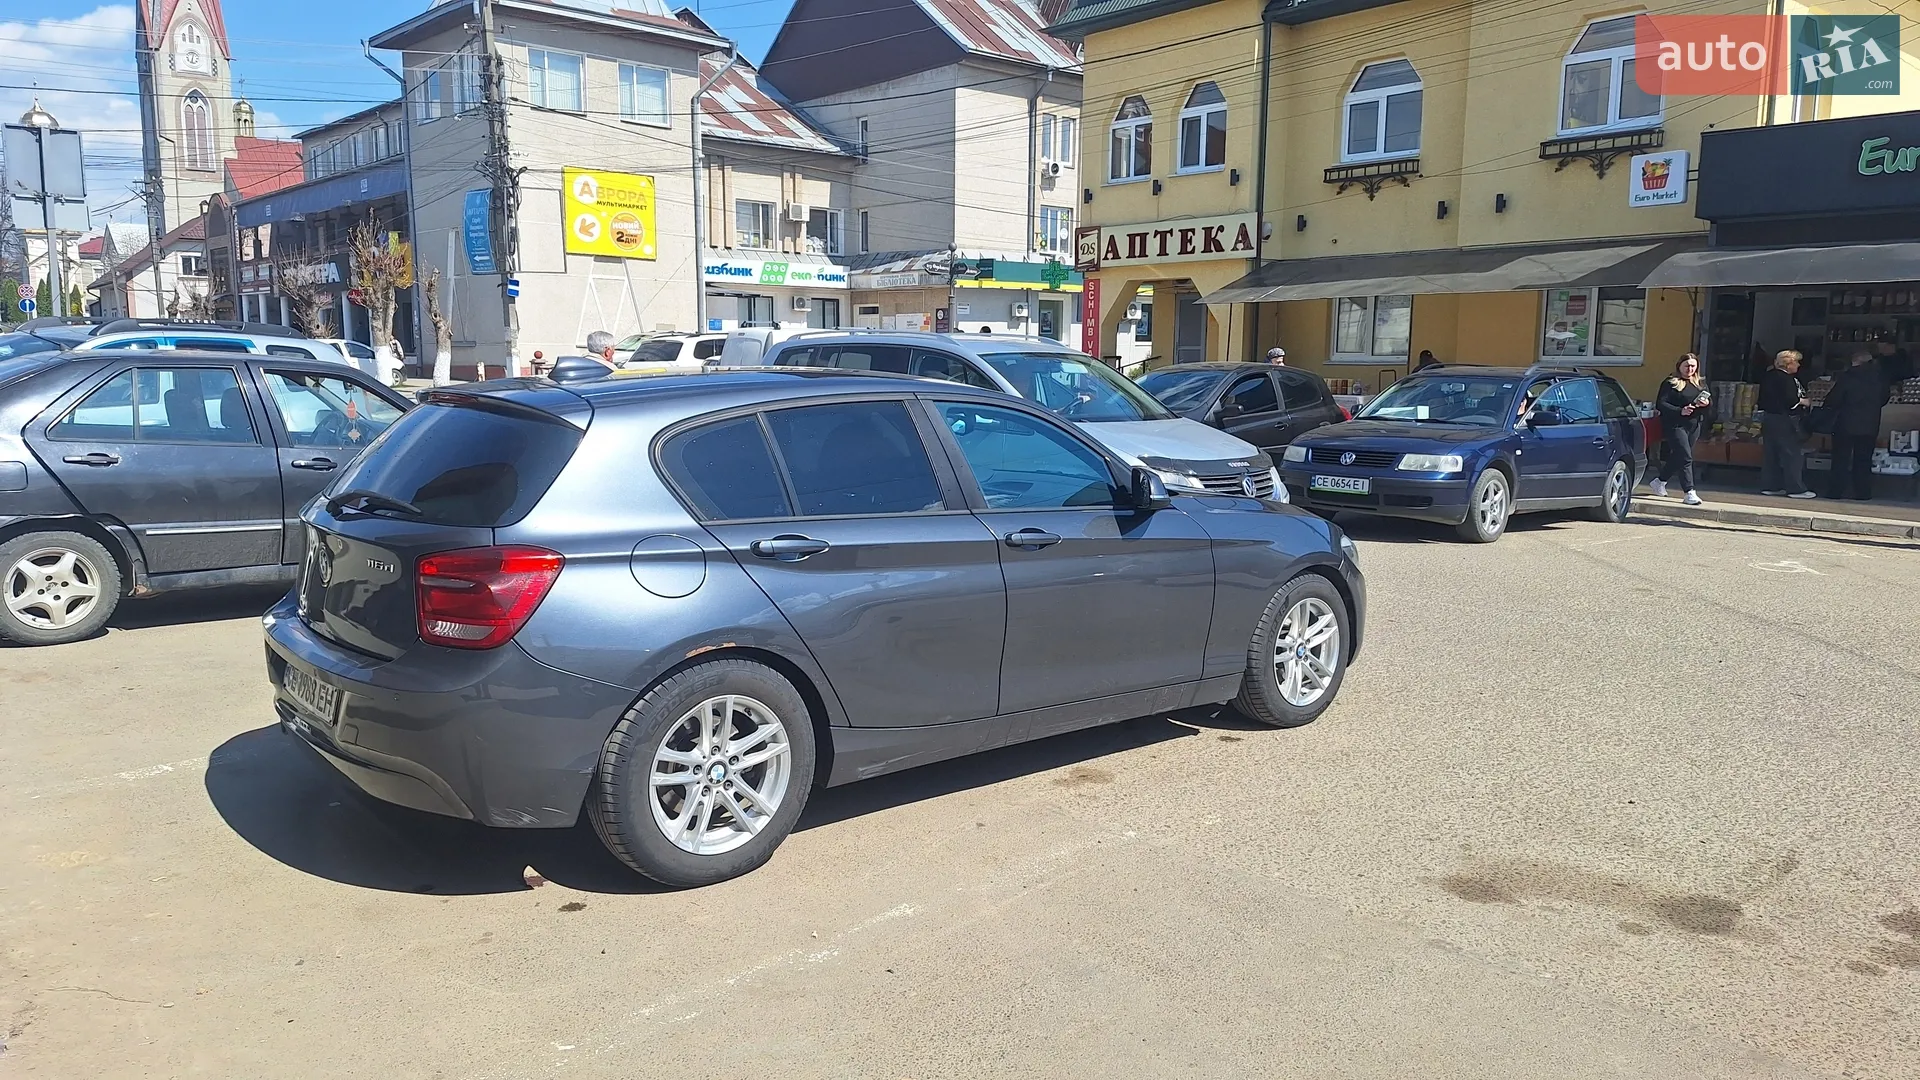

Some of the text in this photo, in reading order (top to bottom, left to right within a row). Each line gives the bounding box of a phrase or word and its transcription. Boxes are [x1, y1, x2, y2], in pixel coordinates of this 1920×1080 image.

[578, 180, 648, 205] АВРОРА
[1634, 190, 1678, 202] Euro Market
[596, 200, 648, 211] МУЛЬТИМАРКЕТ
[1102, 222, 1255, 261] АПТЕКА
[1086, 281, 1095, 336] SCHIMB
[1316, 476, 1329, 488] CE
[1330, 478, 1351, 489] 0654
[367, 559, 394, 573] 116d
[316, 682, 334, 718] EH
